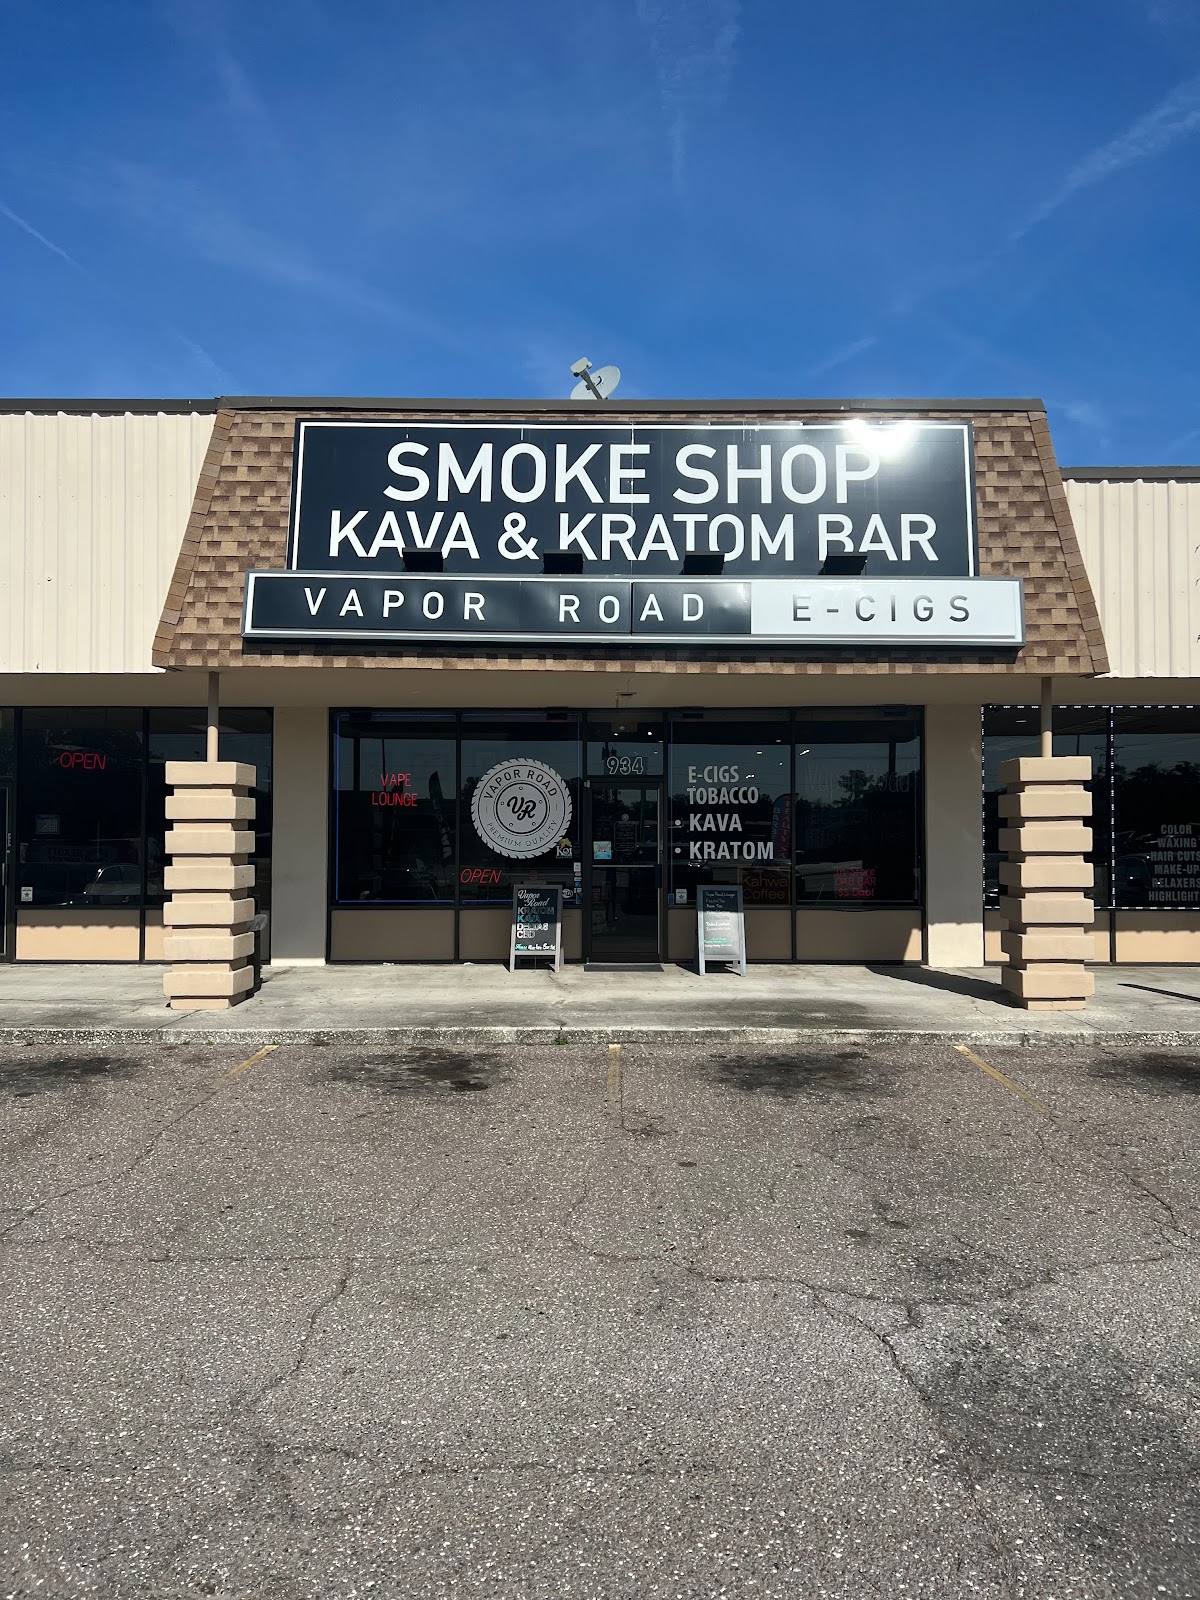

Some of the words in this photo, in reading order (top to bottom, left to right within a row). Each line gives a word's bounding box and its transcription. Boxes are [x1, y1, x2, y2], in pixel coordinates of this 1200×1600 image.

[383, 442, 651, 503] SMOKE
[673, 444, 881, 505] SHOP
[329, 509, 480, 558] KAVA
[497, 512, 539, 560] &
[559, 512, 795, 561] KRATOM
[818, 513, 938, 562] BAR
[303, 587, 486, 621] VAPOR
[557, 592, 705, 624] ROAD
[792, 595, 971, 622] E-CIGS
[59, 752, 107, 770] OPEN
[606, 757, 644, 775] 934
[380, 773, 412, 787] VAPE
[687, 765, 740, 783] E-CIGS
[484, 769, 521, 800] VAPOR
[526, 769, 558, 797] ROAD
[371, 792, 418, 807] LOUNGE
[686, 786, 759, 805] TOBACCO
[507, 796, 537, 821] VR
[689, 814, 742, 832] KAVA
[1160, 824, 1192, 834] COLOR
[487, 823, 522, 847] PREMIUM
[524, 820, 558, 847] QUALITY
[689, 841, 774, 860] KRATOM
[1157, 838, 1197, 848] WAXING
[1150, 851, 1174, 862] HAIR
[460, 868, 502, 885] OPEN
[849, 867, 876, 876] Store
[741, 876, 788, 888] Kahwa
[517, 889, 541, 900] Vapor
[524, 898, 551, 907] Road
[743, 888, 786, 900] Coffee
